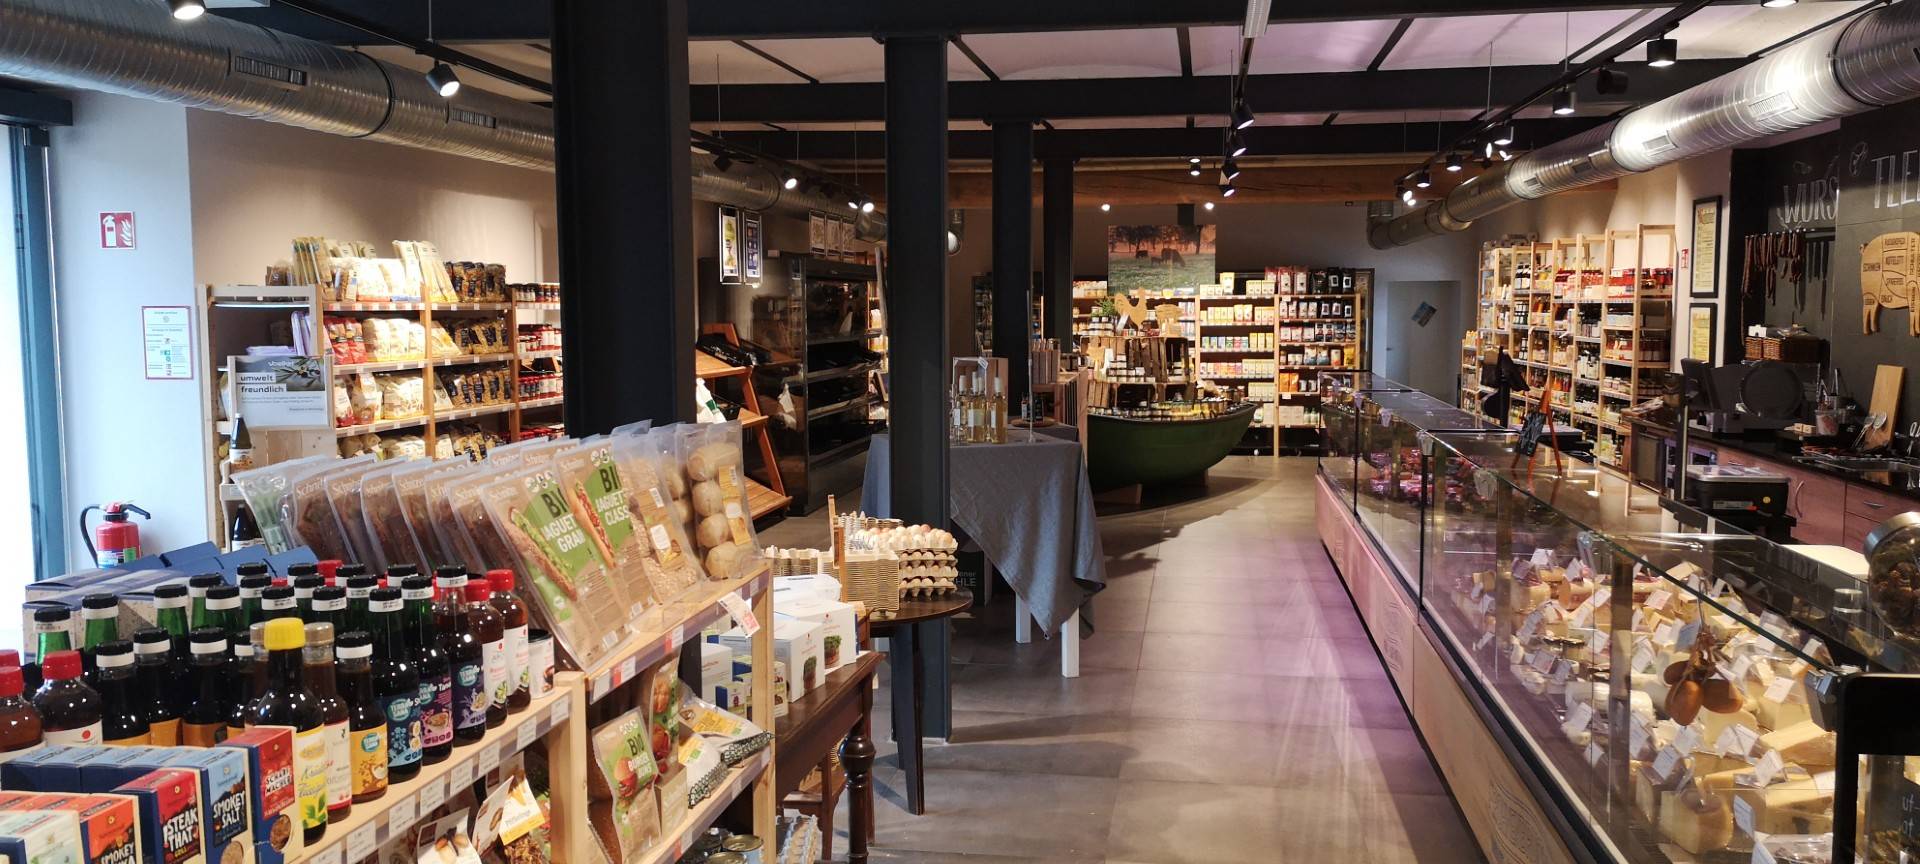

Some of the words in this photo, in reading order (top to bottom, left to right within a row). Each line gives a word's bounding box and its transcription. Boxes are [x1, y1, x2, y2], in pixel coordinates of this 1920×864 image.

[240, 374, 273, 382] umwelt
[241, 385, 284, 393] freundlich
[599, 465, 622, 493] BI
[541, 487, 568, 518] BI
[213, 790, 245, 818] SMOKEY
[167, 808, 198, 835] STEAK
[221, 809, 240, 828] SALT
[168, 826, 194, 852] THAT
